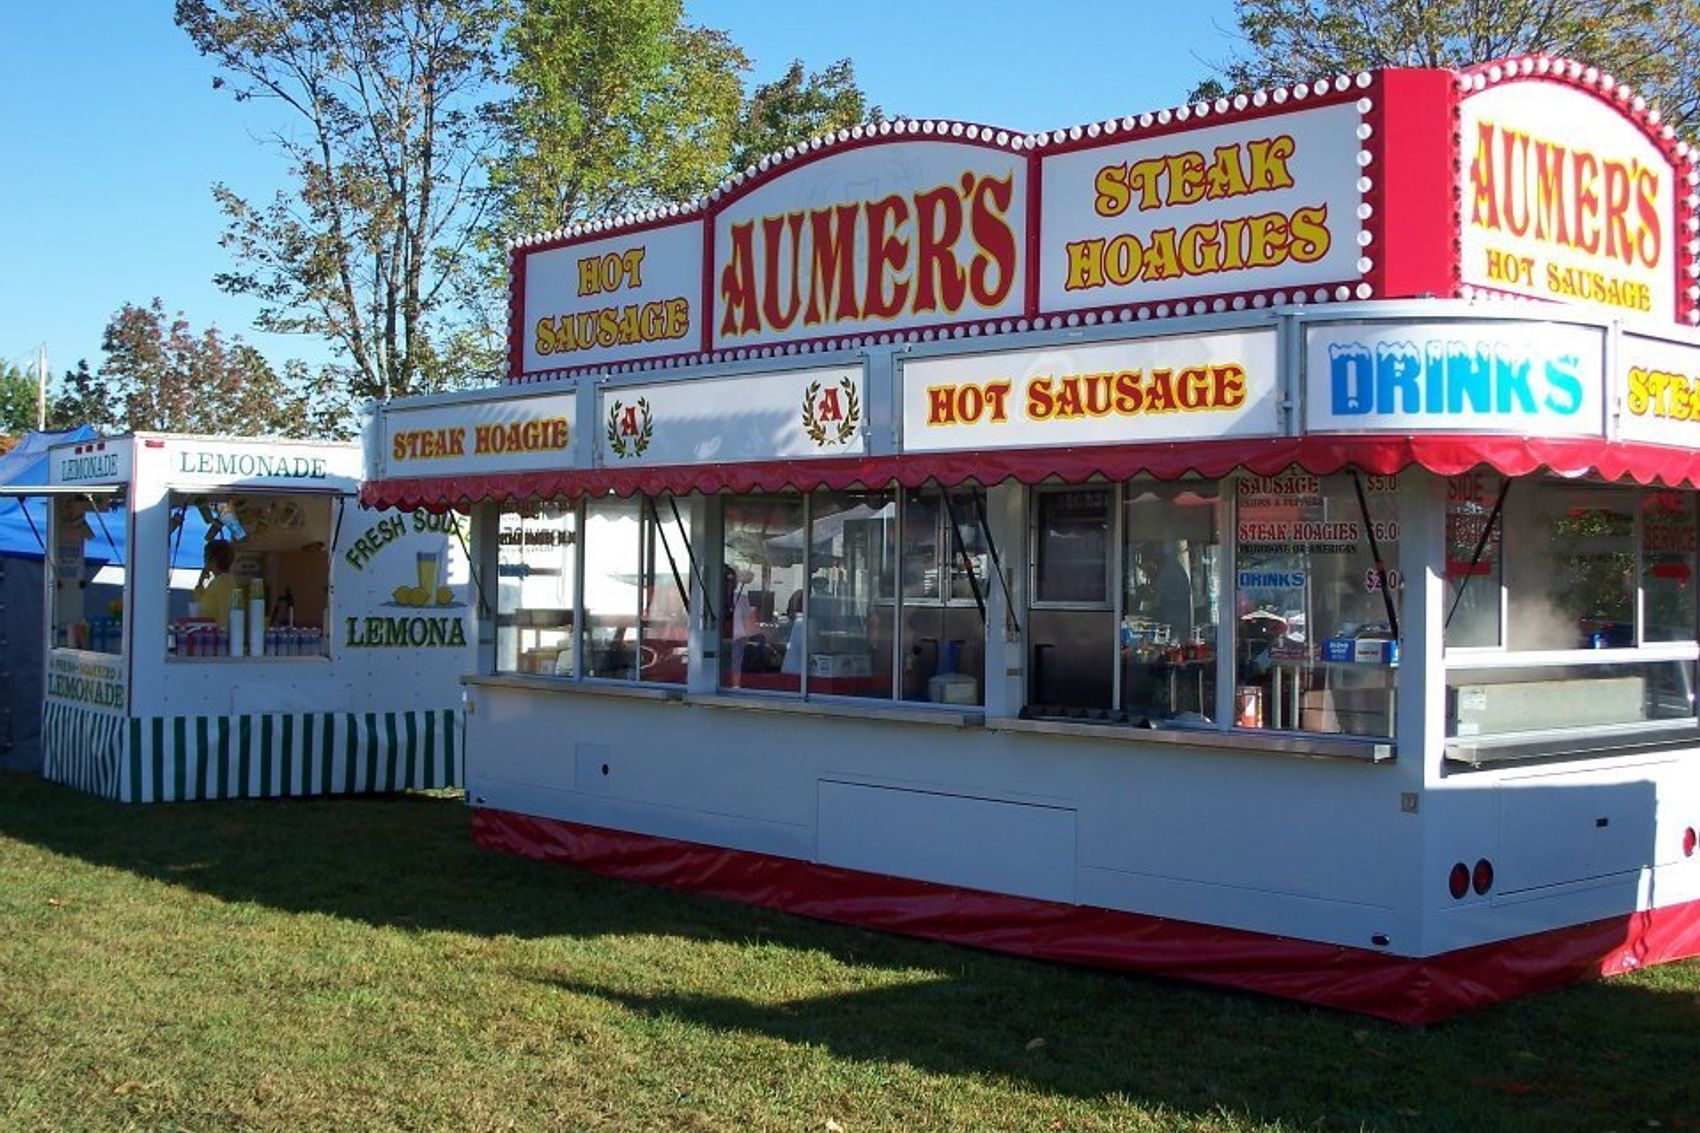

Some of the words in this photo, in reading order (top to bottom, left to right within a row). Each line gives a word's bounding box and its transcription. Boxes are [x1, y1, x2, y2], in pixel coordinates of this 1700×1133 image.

[1094, 134, 1296, 217] STEAK
[1470, 120, 1662, 269] AUMER'S
[578, 246, 645, 297] HOT
[720, 169, 1017, 336] AUMER'S
[1065, 203, 1331, 292] HOAGIES
[1486, 249, 1536, 286] HOT
[1547, 262, 1651, 312] SAUSAGE
[535, 297, 689, 356] SAUSAGE
[926, 379, 1011, 426] HOT
[1026, 361, 1246, 421] SAUSAGE
[1328, 340, 1583, 417] DRINKS
[621, 407, 639, 436] A
[818, 388, 842, 422] A
[392, 427, 465, 462] STEAK
[475, 417, 569, 455] HOAGIE
[62, 454, 118, 481] LEMONADE
[179, 452, 327, 479] LEMONADE
[1239, 476, 1319, 495] SAUSAGE
[1367, 475, 1398, 491] $5.0
[345, 514, 406, 571] FRESH
[1239, 523, 1287, 541] STEAK
[1293, 523, 1358, 541] HOAGIES
[1368, 523, 1398, 541] 6.0
[1239, 571, 1304, 588] DRINKS
[48, 673, 124, 709] LEMONADE
